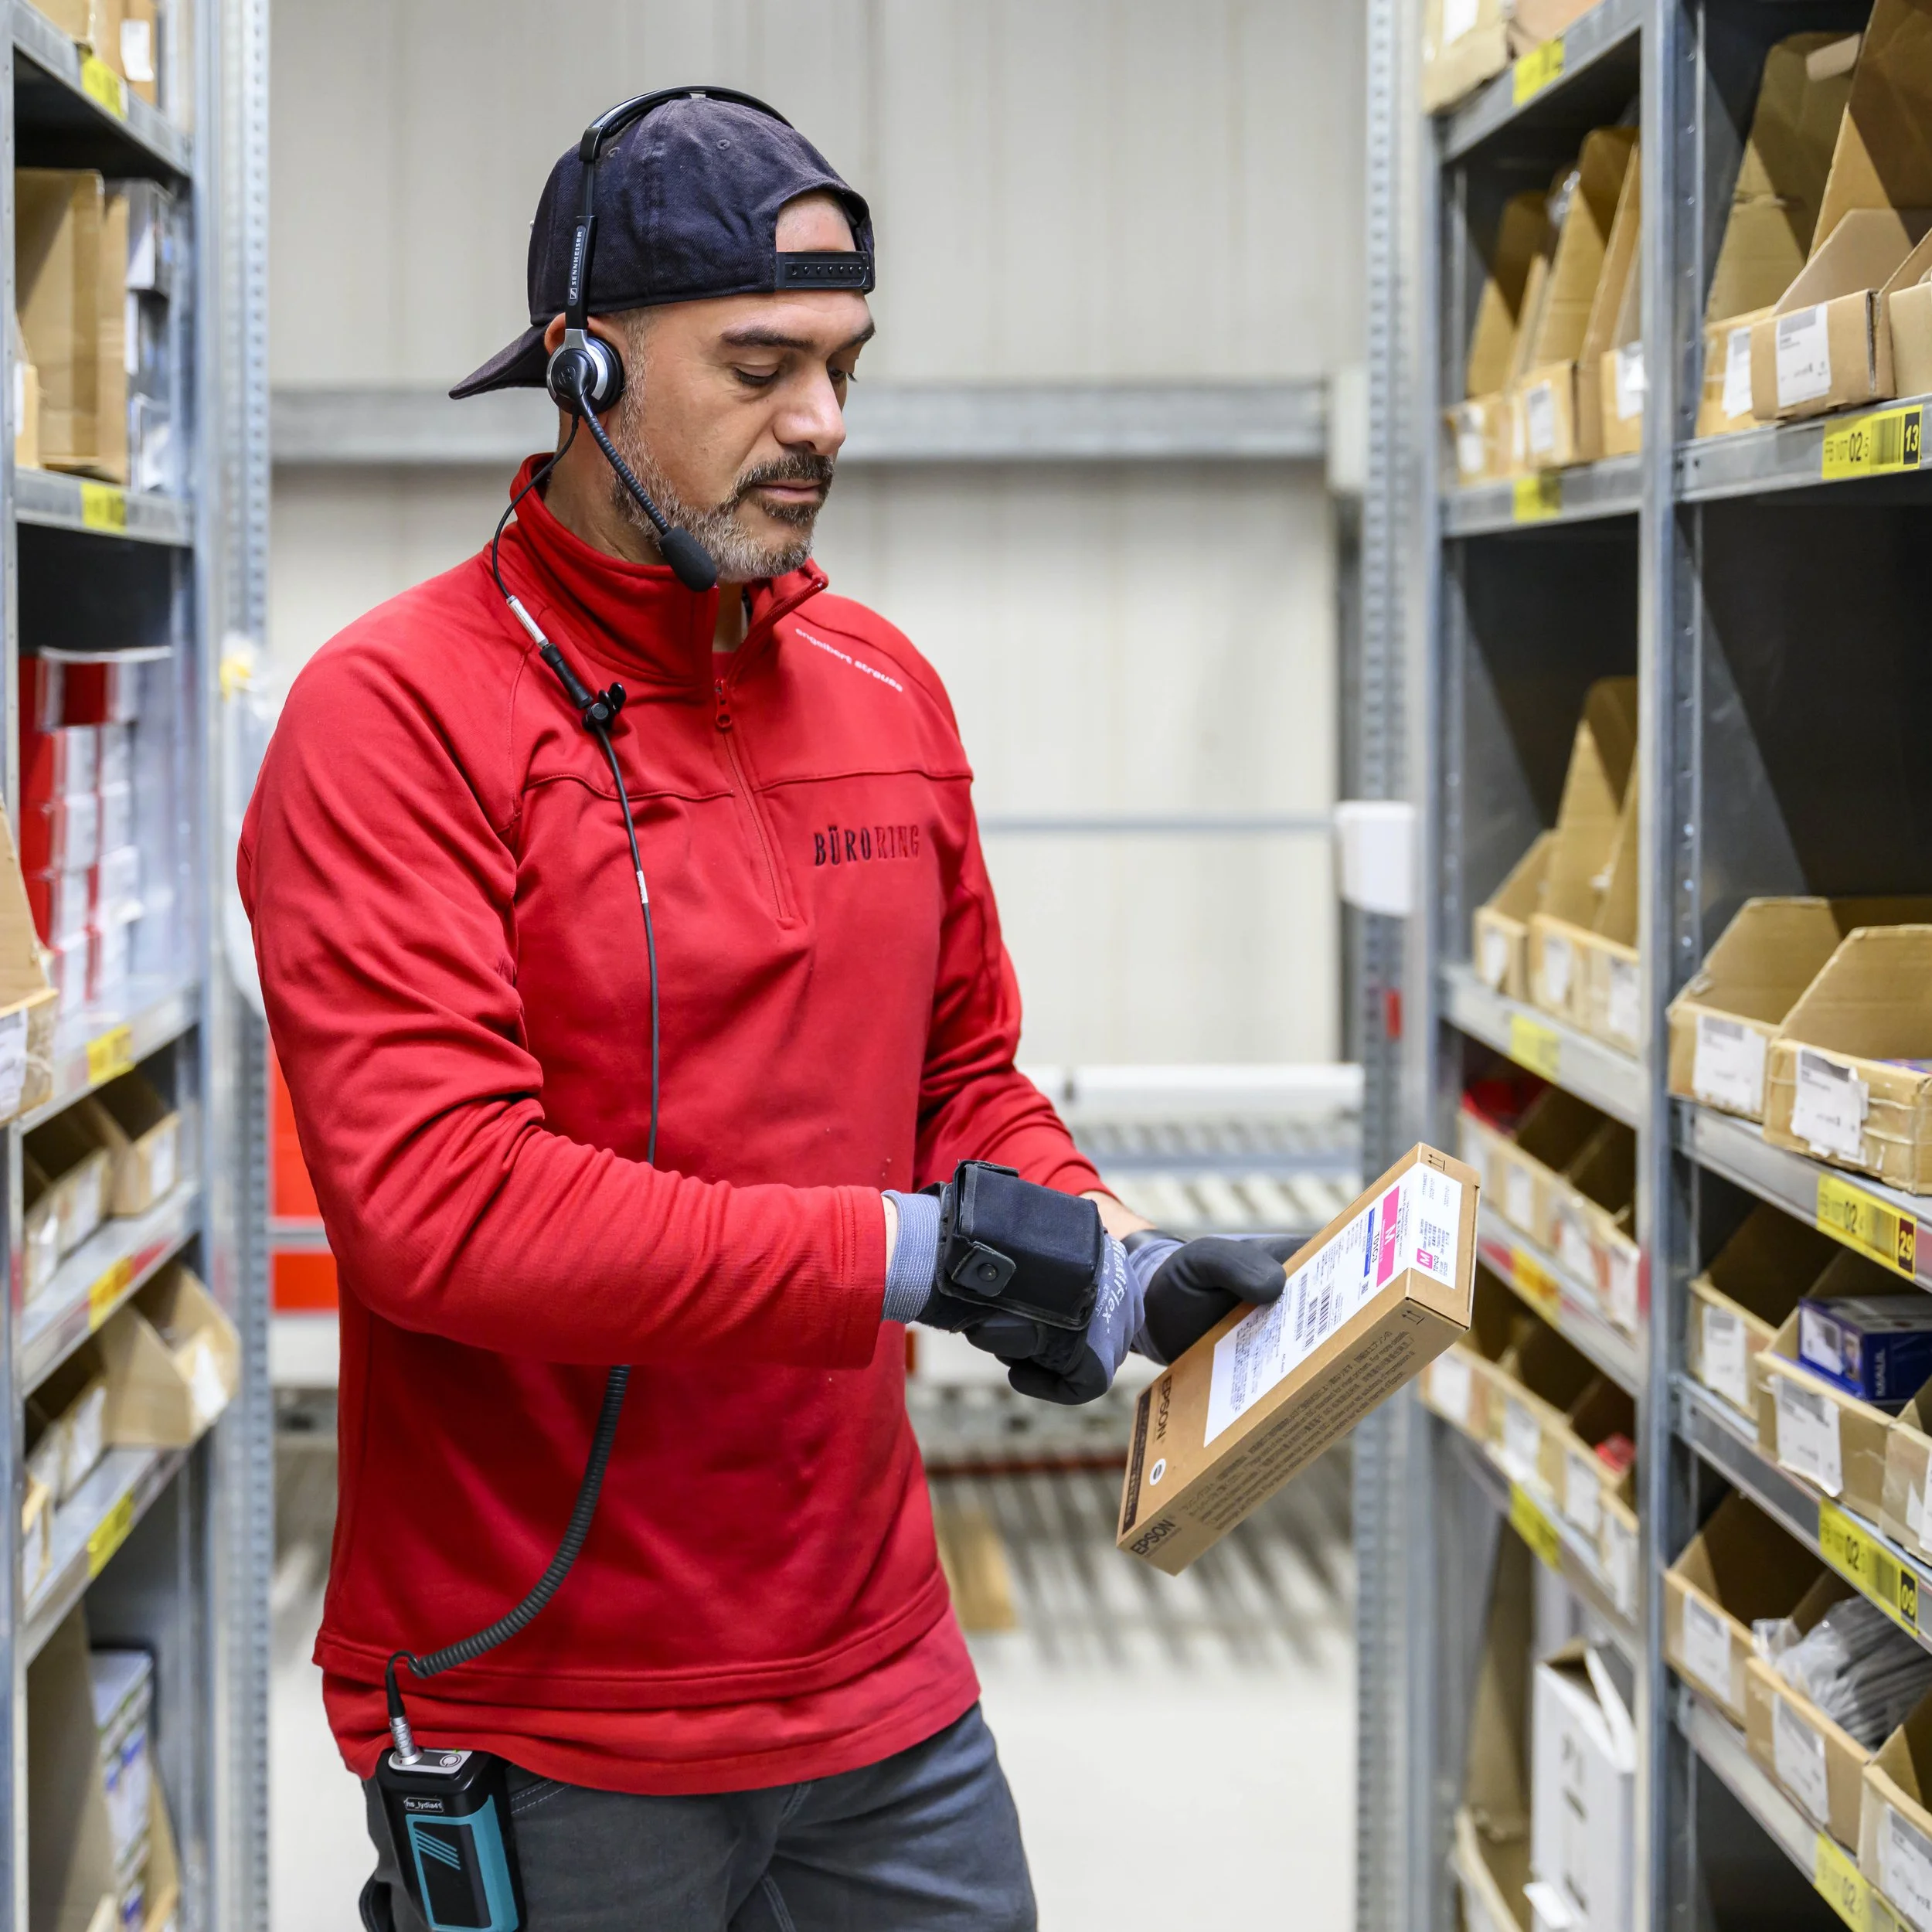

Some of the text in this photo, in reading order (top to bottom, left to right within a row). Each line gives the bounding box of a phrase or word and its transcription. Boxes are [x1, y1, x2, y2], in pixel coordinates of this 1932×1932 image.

[572, 231, 583, 286] SENNHEISER
[1849, 431, 1862, 462] 02
[1906, 423, 1919, 452] 13
[795, 628, 903, 692] engelbert strauss
[814, 824, 920, 866] BÜRORING
[1384, 1223, 1396, 1246] M
[1899, 1230, 1913, 1261] 29
[1420, 1251, 1430, 1264] M
[1156, 1376, 1172, 1440] EPSON
[1131, 1519, 1175, 1556] EPSON
